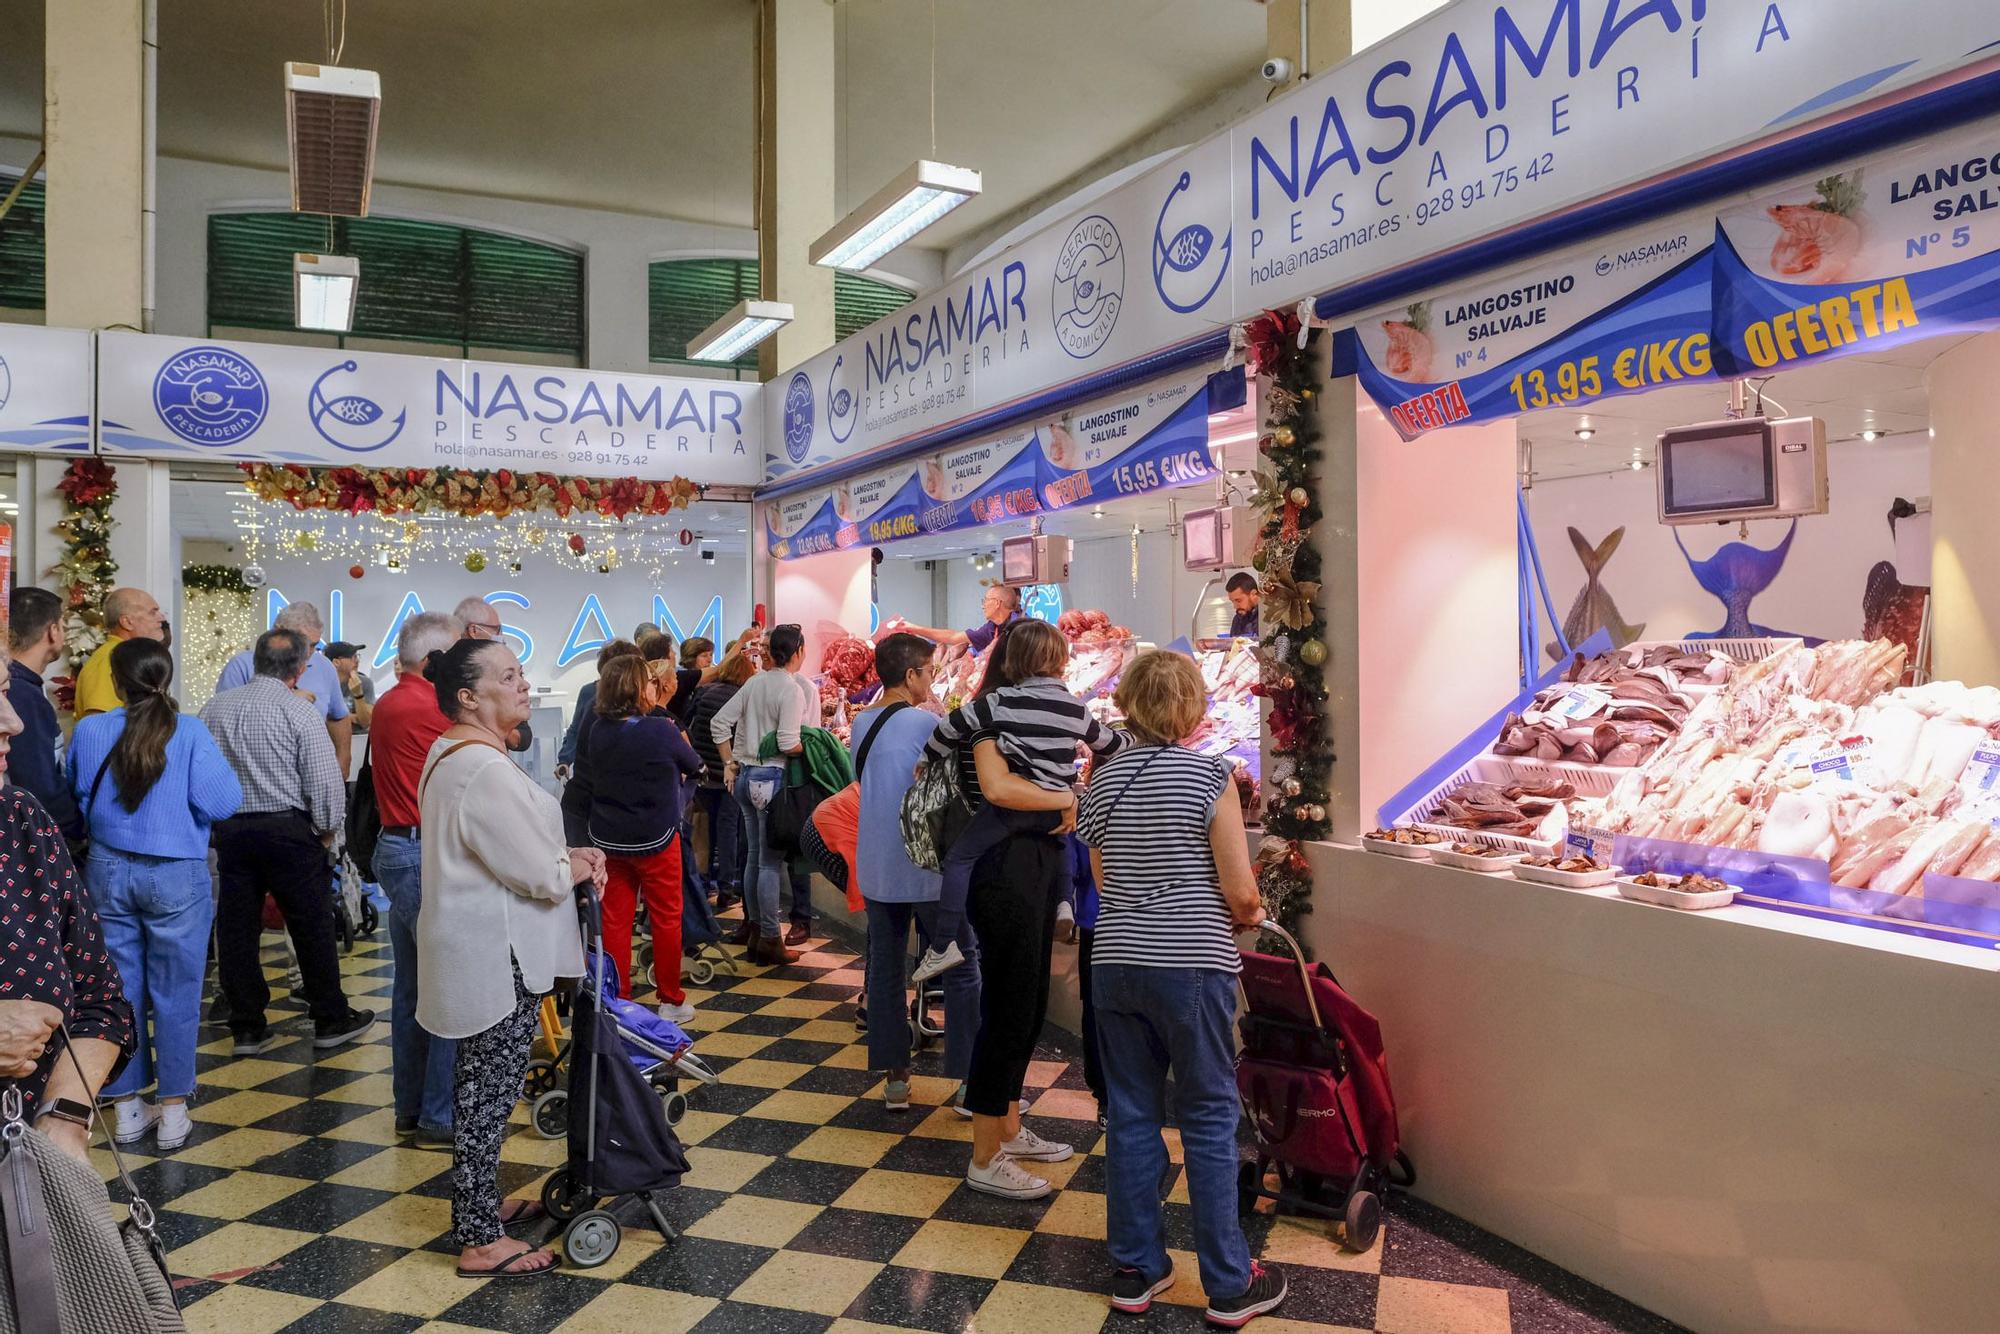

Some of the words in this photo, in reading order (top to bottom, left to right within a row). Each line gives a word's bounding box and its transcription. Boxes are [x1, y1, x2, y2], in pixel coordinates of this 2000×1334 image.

[1251, 0, 1706, 220] NASAMA
[1251, 3, 1790, 259] PESCADERÍA
[1250, 214, 1401, 286] hola@nasamar.es
[1416, 189, 1455, 227] 928
[1460, 182, 1486, 209] 91
[1491, 167, 1519, 199] 75
[1525, 152, 1554, 182] 42
[1932, 185, 2000, 221] SAL
[1062, 224, 1113, 269] SERVICIO
[1617, 235, 1687, 265] NASAMAR
[1952, 226, 1970, 248] 5
[1444, 275, 1575, 326] LANGOSTINO
[866, 261, 1026, 391] NASAMAR
[1069, 302, 1116, 349] DOMICILIO
[1467, 308, 1546, 342] SALVAJE
[1744, 277, 1920, 368] OFERTA
[172, 355, 251, 383] NASAMAR
[1478, 347, 1487, 362] 4
[865, 329, 1029, 415] PESCADERÍA
[1509, 356, 1602, 412] 13,95
[1612, 333, 1712, 389] €/KG
[436, 369, 742, 435] NASAMAR
[922, 394, 935, 414] 928
[936, 393, 944, 408] 91
[946, 389, 954, 404] 75
[957, 385, 965, 400] 42
[1391, 381, 1472, 435] OFERTA
[1079, 405, 1139, 432] LANGOSTINO
[1091, 425, 1127, 444] SALVAJE
[434, 442, 558, 460] hola@nasamar.es
[568, 450, 592, 463] 928
[597, 453, 611, 465] 91
[615, 453, 630, 466] 75
[633, 455, 648, 465] 42
[435, 421, 746, 455] PESCADERÍA
[1096, 448, 1101, 459] 3
[947, 448, 990, 469] LANGOSTINO
[956, 465, 982, 480] SALVAJE
[853, 479, 886, 495] LANGOSTINO
[1044, 470, 1093, 509] OFERTA
[1113, 459, 1159, 494] 15,95
[923, 501, 959, 532] OFERTA
